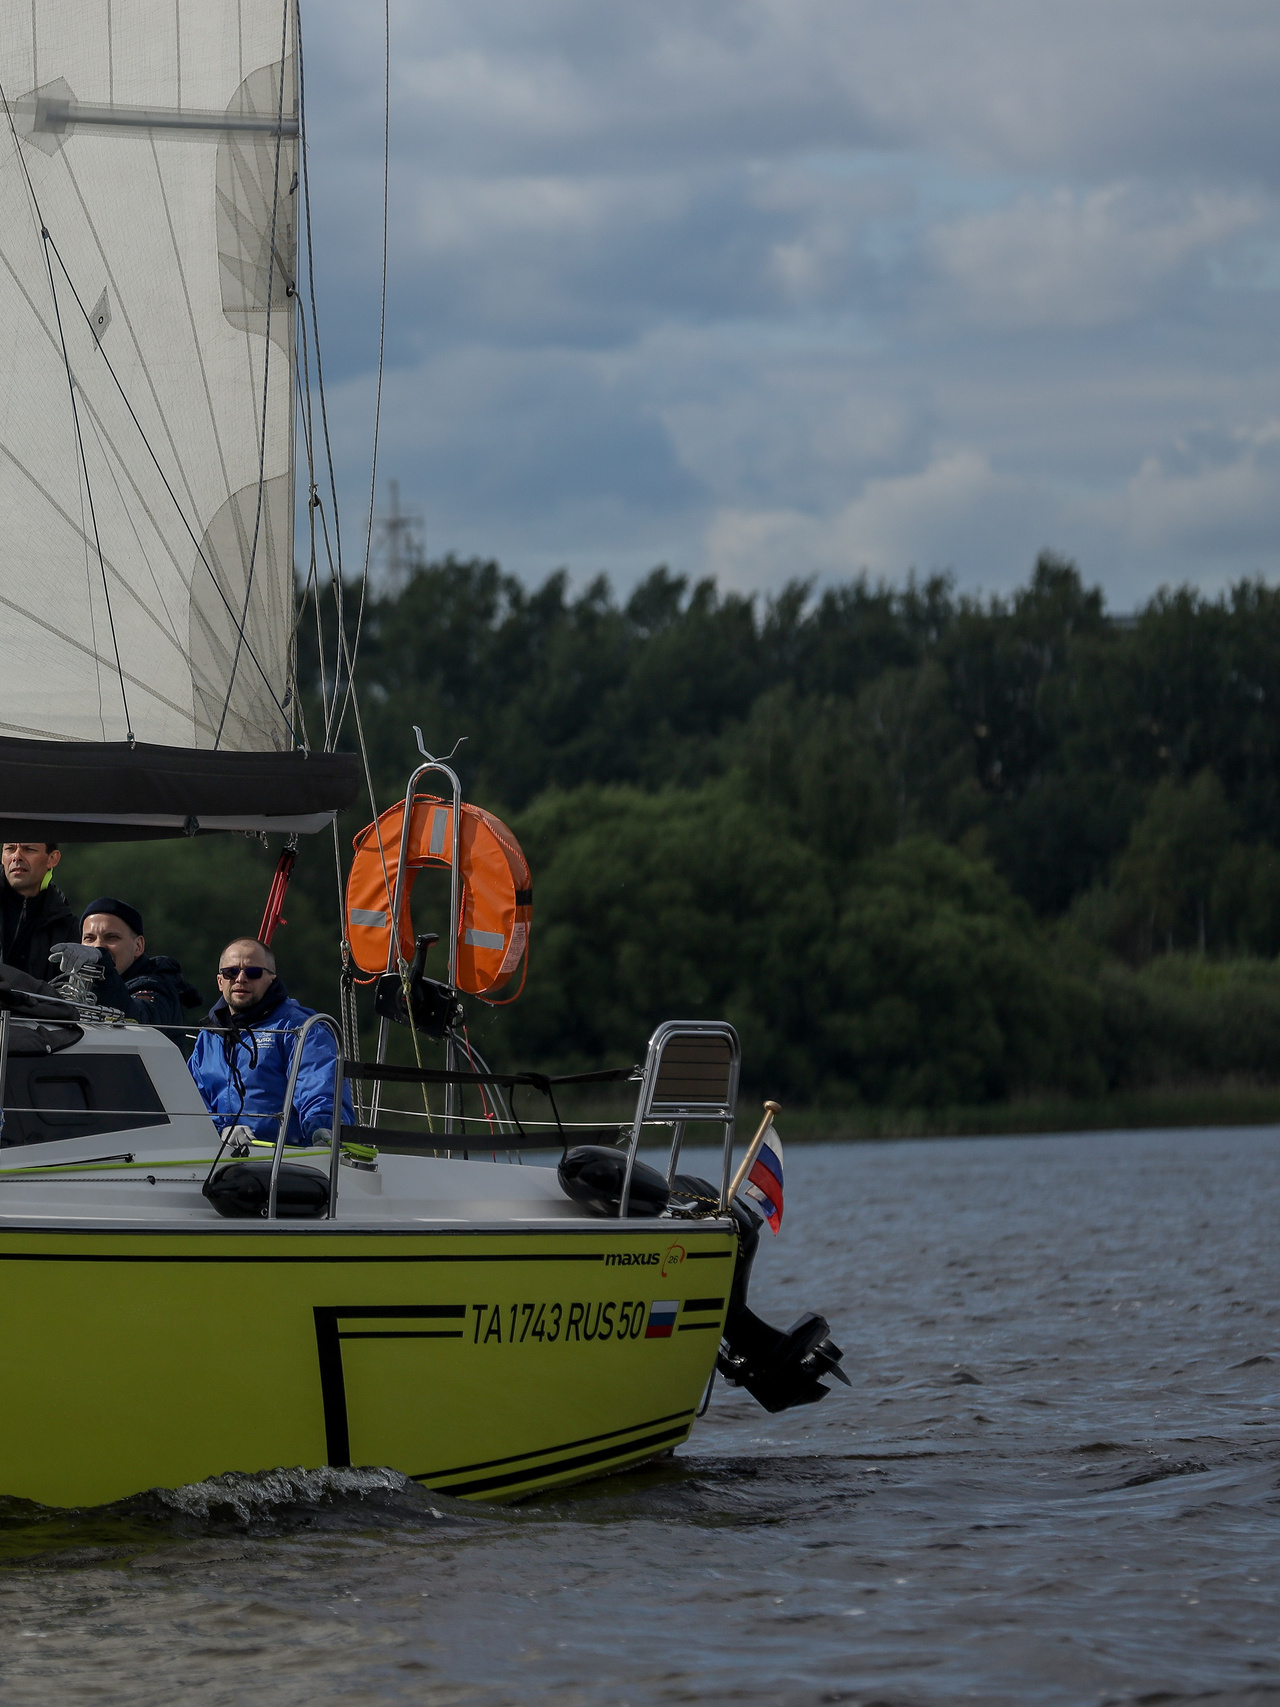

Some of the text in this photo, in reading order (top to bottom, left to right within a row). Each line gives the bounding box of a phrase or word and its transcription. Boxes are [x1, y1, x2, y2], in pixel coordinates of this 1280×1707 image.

[605, 1252, 679, 1266] maxus 26
[472, 1304, 502, 1344] TA
[509, 1302, 563, 1343] 1743
